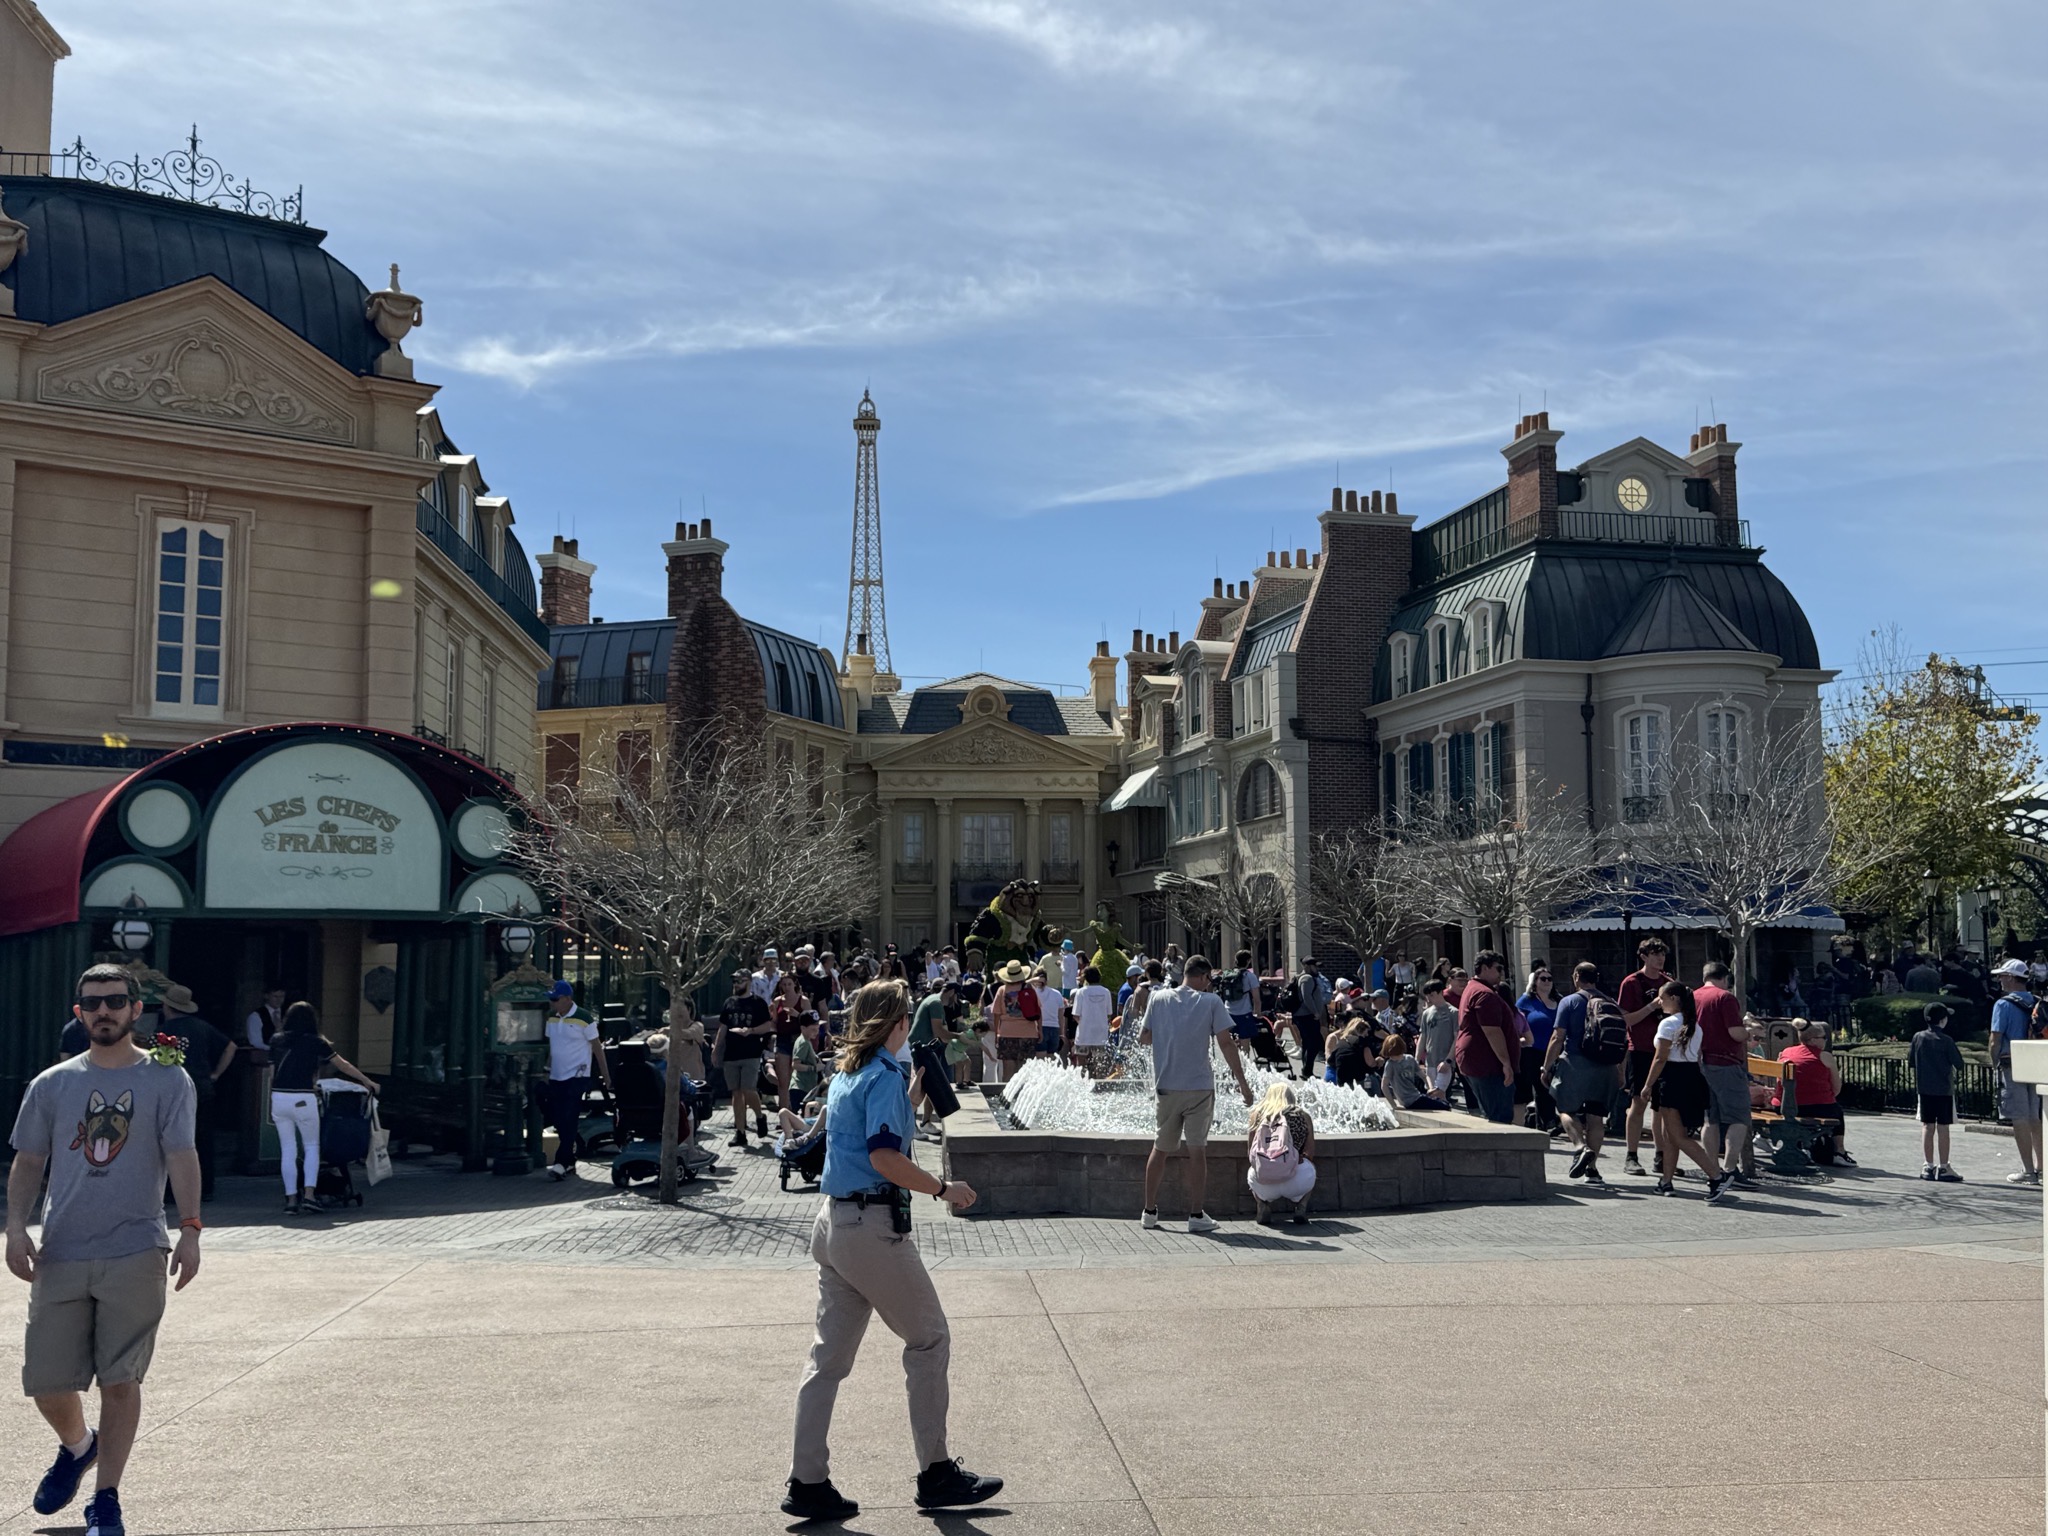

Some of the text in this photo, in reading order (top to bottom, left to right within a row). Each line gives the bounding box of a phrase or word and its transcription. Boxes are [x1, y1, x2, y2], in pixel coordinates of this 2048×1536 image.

[254, 796, 401, 832] LES CHEFS
[318, 820, 339, 834] de
[278, 833, 377, 855] FRANCE
